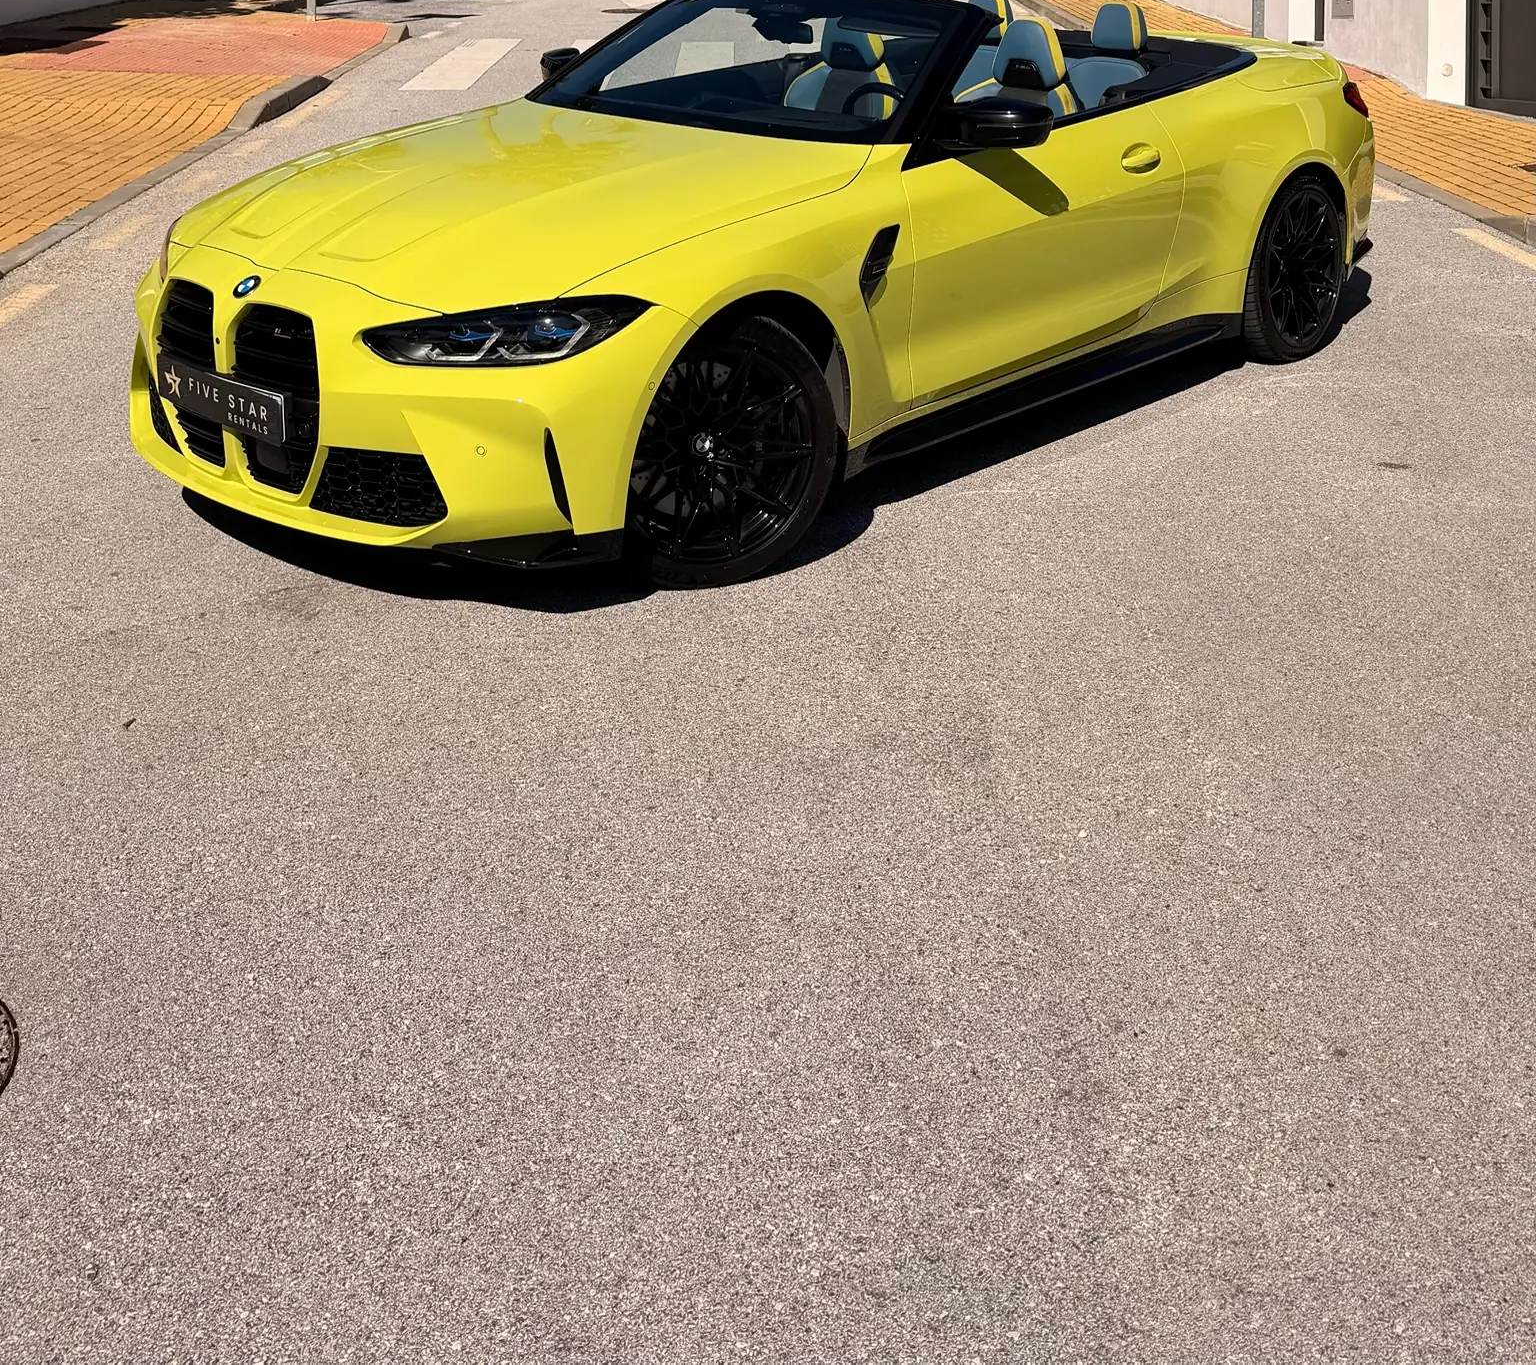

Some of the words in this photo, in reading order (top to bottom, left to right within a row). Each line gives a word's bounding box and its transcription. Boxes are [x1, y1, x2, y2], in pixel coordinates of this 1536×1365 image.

[188, 377, 220, 403] FIVE
[228, 394, 268, 422] STAR
[227, 412, 268, 435] RENTALS
